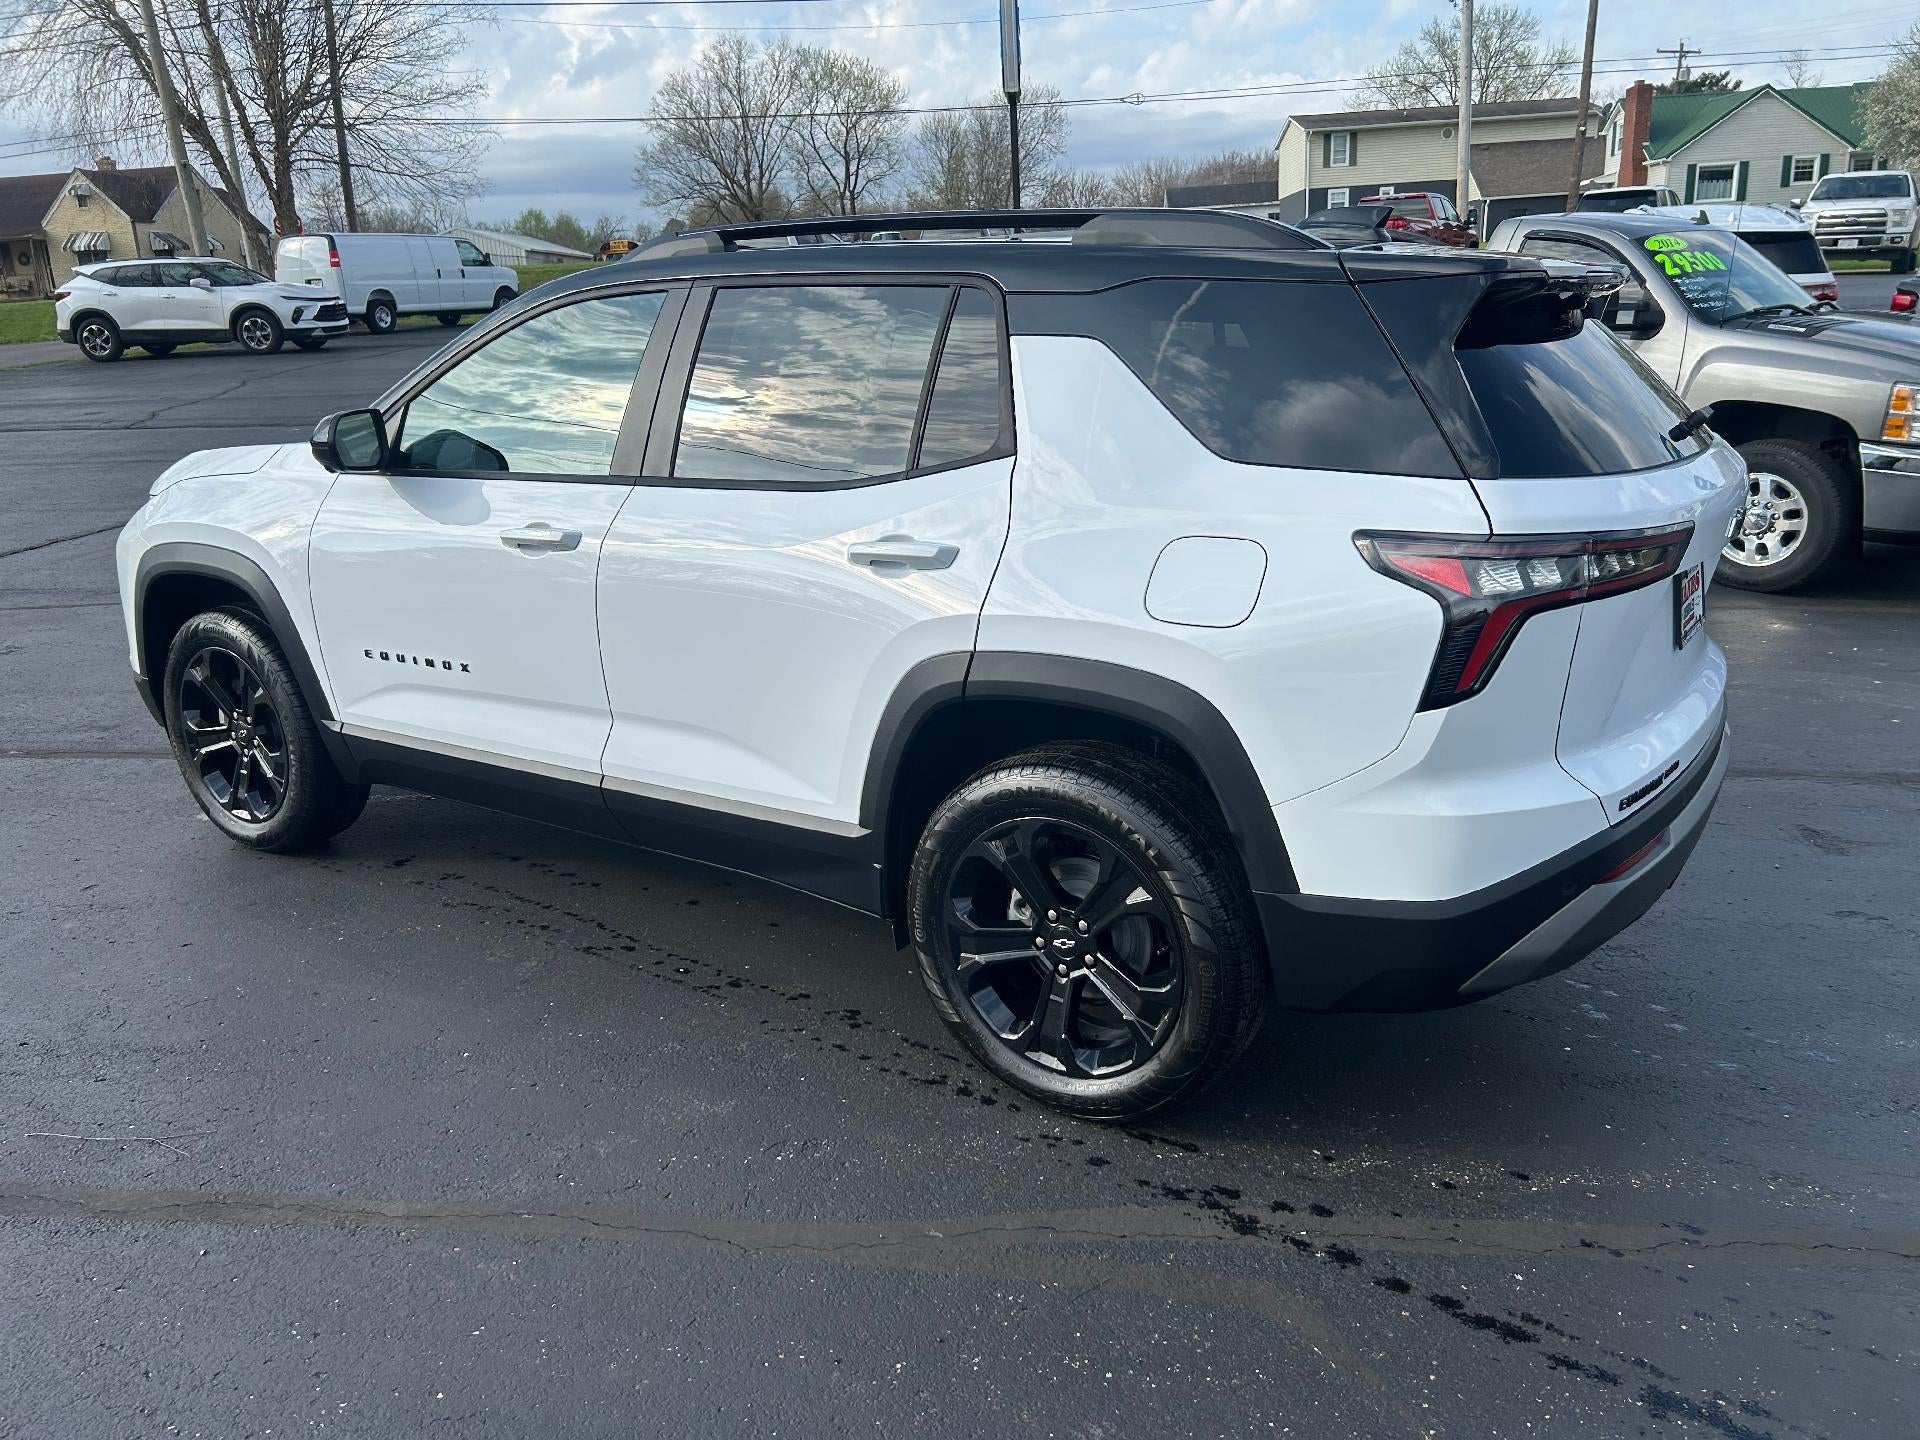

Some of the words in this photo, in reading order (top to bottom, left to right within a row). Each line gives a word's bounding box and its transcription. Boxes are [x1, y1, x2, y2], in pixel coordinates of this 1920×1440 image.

[1653, 238, 1681, 250] 2014
[1654, 251, 1727, 275] 29500
[363, 649, 471, 673] EQUINOX
